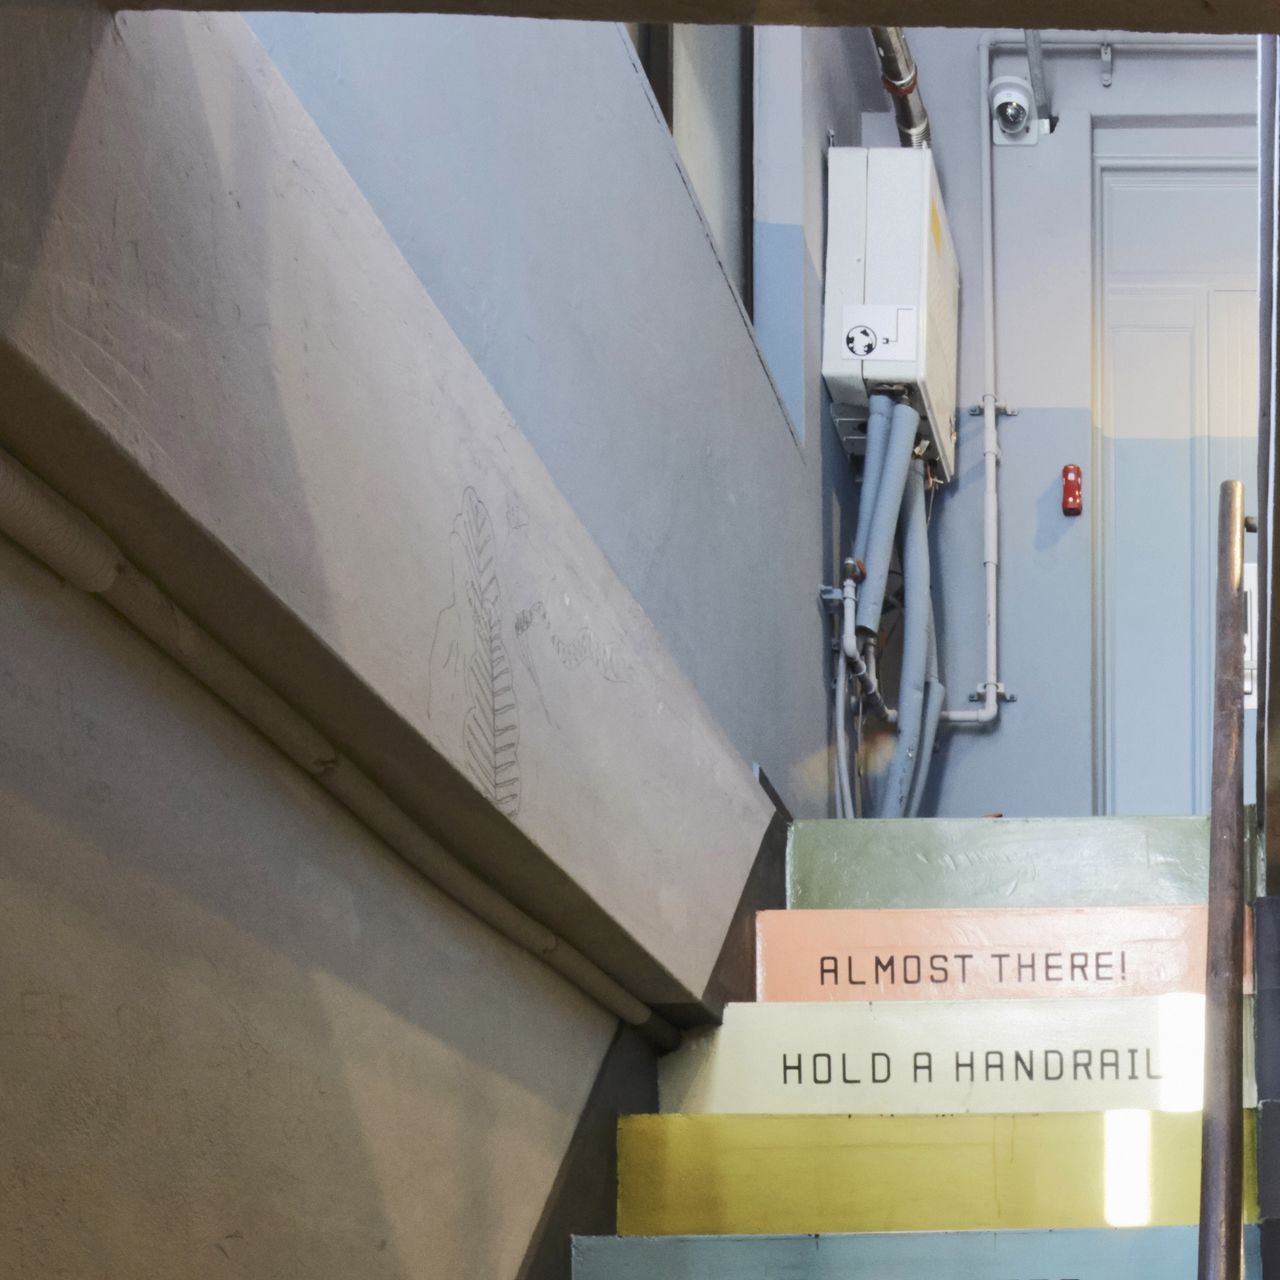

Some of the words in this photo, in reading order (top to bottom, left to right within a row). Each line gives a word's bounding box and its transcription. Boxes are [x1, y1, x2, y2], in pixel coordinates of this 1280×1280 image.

[819, 953, 974, 985] ALMOST
[991, 951, 1127, 983] THERE!
[783, 1052, 891, 1084] HOLD
[913, 1051, 933, 1083] A
[955, 1048, 1164, 1082] HANDRAIL
